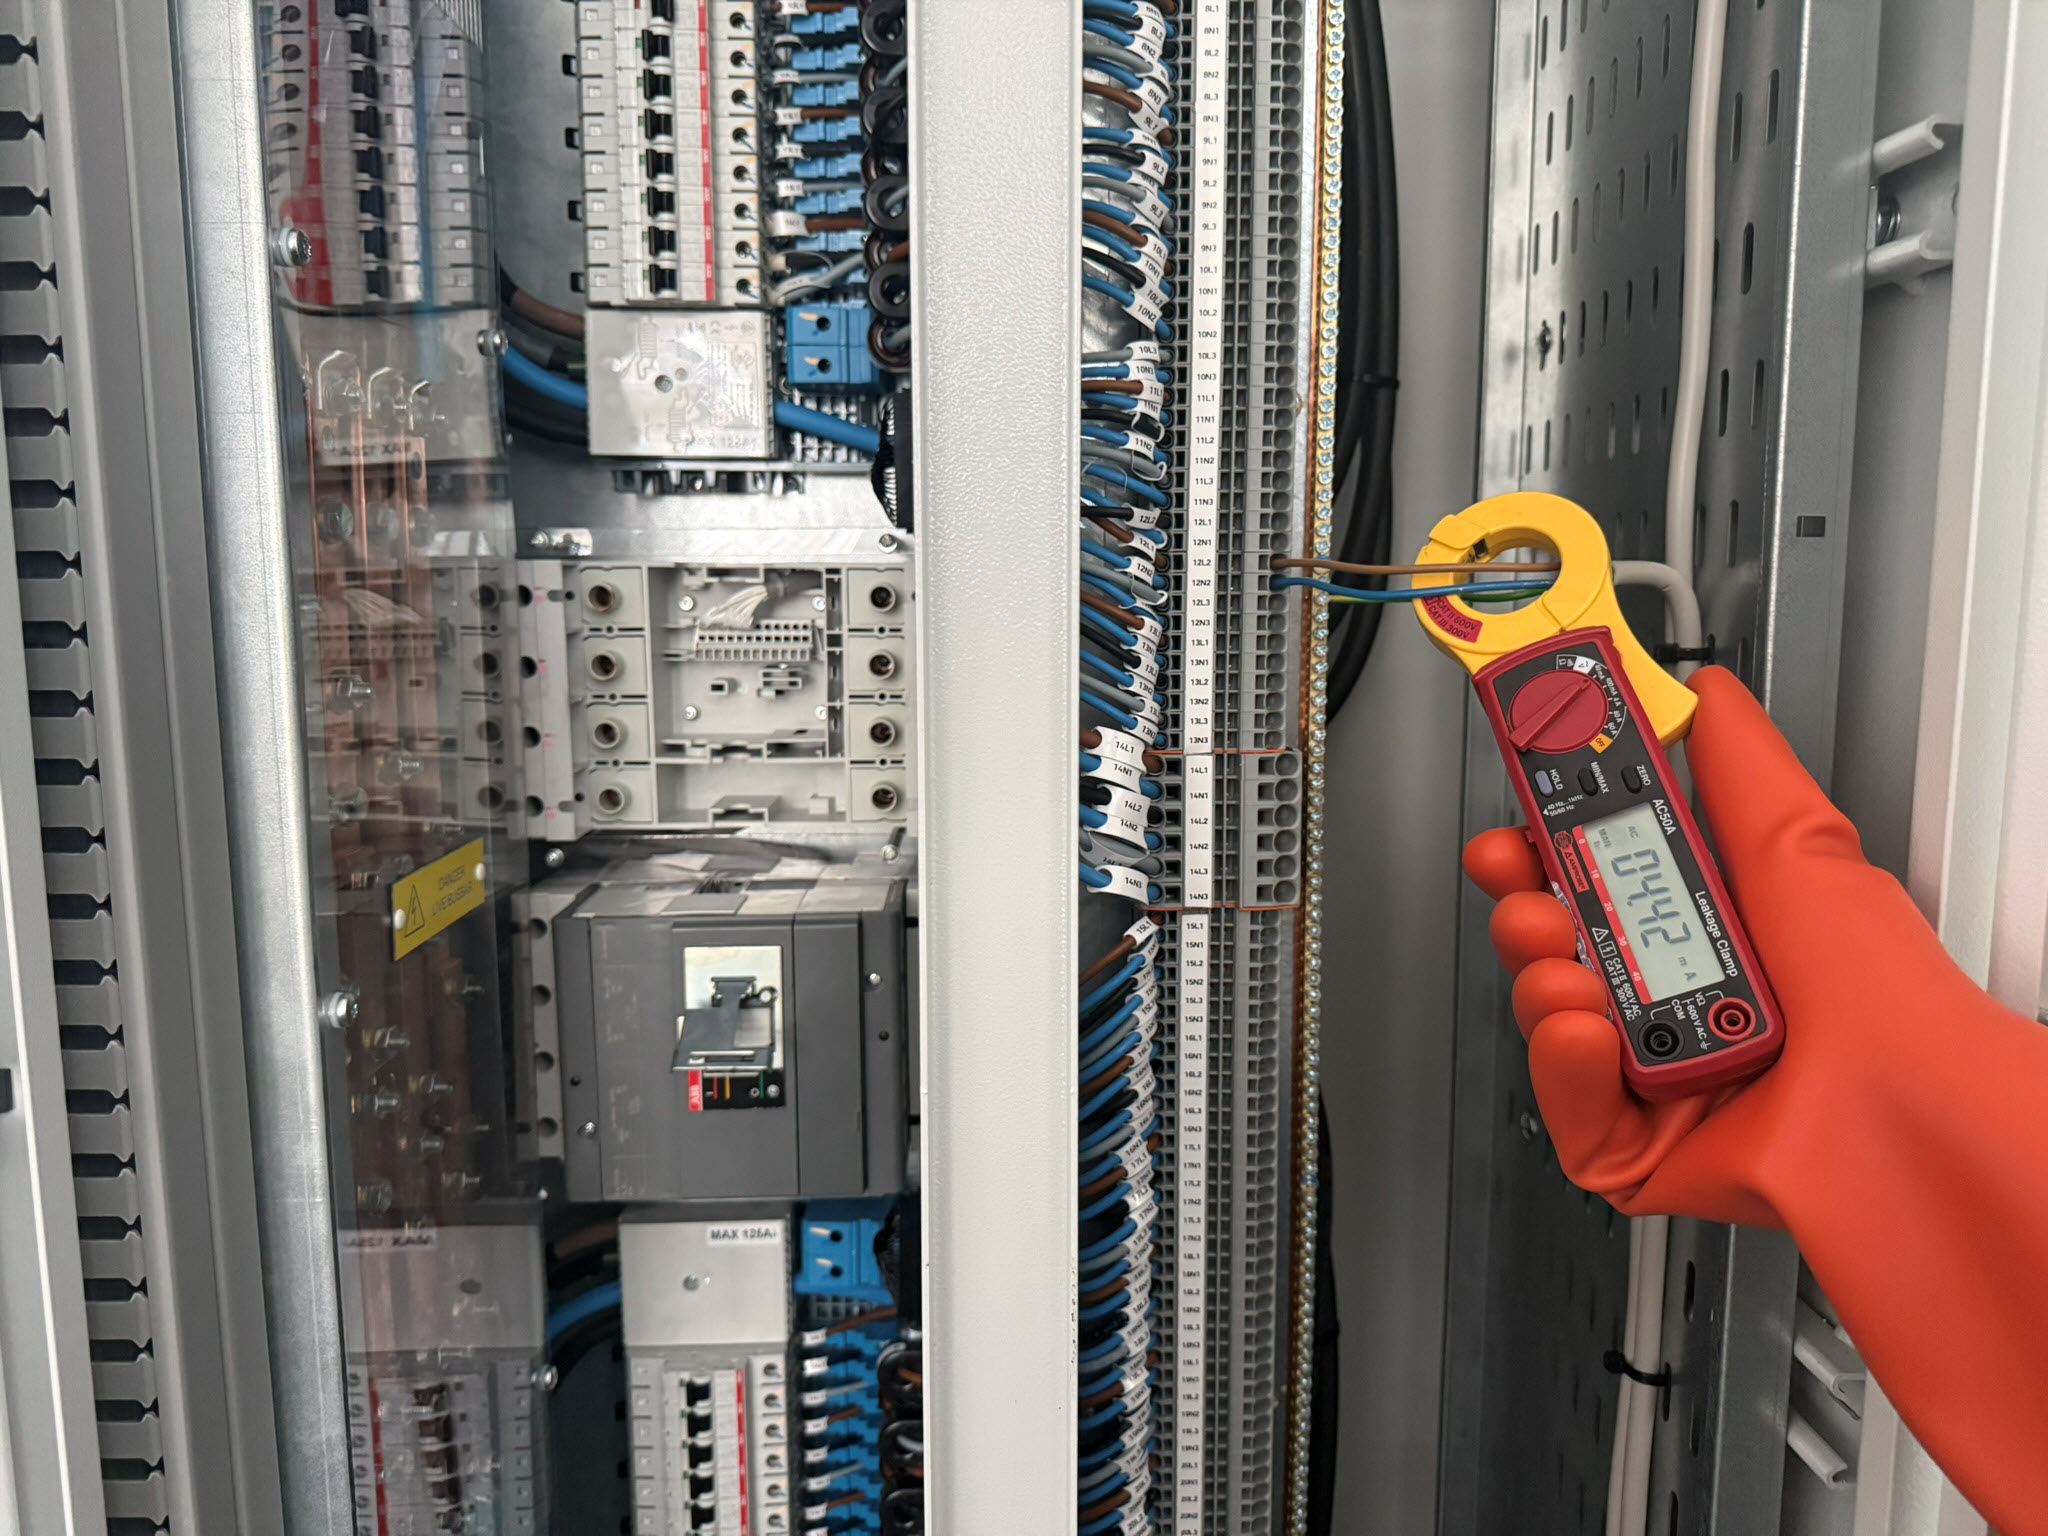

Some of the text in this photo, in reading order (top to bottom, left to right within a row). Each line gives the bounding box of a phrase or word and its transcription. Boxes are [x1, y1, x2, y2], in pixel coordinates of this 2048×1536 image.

[1204, 4, 1219, 13] 8L1
[1150, 26, 1163, 41] 8L2
[1203, 26, 1220, 35] 8N1
[1141, 42, 1156, 58] 8N2
[1204, 49, 1220, 57] 8L2
[1203, 71, 1220, 79] 8N2
[1203, 92, 1219, 101] 8L3
[1143, 116, 1158, 131] 9L1
[1202, 115, 1219, 123] 8N3
[1202, 136, 1218, 145] 9L1
[1201, 158, 1218, 166] 9N1
[1152, 162, 1165, 176] 9L2
[1202, 179, 1218, 188] 9L2
[1201, 201, 1218, 209] 9N2
[1150, 204, 1164, 219] 9L3
[1201, 222, 1217, 231] 9L3
[1200, 244, 1217, 252] 9N3
[1145, 260, 1160, 279] 10N1
[1199, 265, 1218, 274] 10L1
[1198, 287, 1218, 296] 10N1
[1138, 305, 1156, 322] 10N2
[1198, 308, 1218, 317] 10L2
[1197, 330, 1218, 338] 10N2
[1139, 346, 1157, 355] 10L3
[1197, 352, 1217, 360] 10L3
[1196, 373, 1217, 381] 10N3
[1196, 394, 1215, 402] 11L1
[1195, 415, 1215, 424] 11N1
[1195, 436, 1215, 445] 11L2
[1194, 456, 1215, 465] 11N2
[1194, 477, 1214, 486] 11L3
[1193, 498, 1214, 506] 11N3
[1193, 518, 1212, 526] 12L1
[1139, 539, 1155, 552] 12L1
[1192, 538, 1212, 547] 12N1
[1192, 558, 1212, 567] 12L2
[1191, 578, 1212, 587] 12N2
[1191, 598, 1211, 607] 12L3
[1190, 618, 1211, 627] 12N3
[1428, 605, 1442, 620] CAT
[1446, 624, 1470, 639] 300V
[1454, 616, 1477, 631] 600V
[1191, 638, 1209, 647] 13L1
[1189, 658, 1209, 667] 13N1
[1190, 678, 1210, 686] 13L2
[1189, 697, 1210, 706] 13N2
[1189, 717, 1209, 725] 13L3
[1188, 736, 1209, 744] 13N3
[1595, 737, 1605, 747] OFF
[1115, 741, 1135, 754] 14L1
[1113, 763, 1133, 777] 14N1
[1189, 766, 1208, 774] 14L1
[1549, 769, 1564, 791] HOLD
[1590, 761, 1610, 794] MIN/MAX
[1636, 765, 1651, 786] ZERO
[1189, 792, 1209, 800] 14N1
[1124, 800, 1143, 813] 14L2
[1189, 817, 1209, 825] 14L2
[1652, 798, 1677, 836] AC50A
[1120, 819, 1139, 832] 14N2
[1627, 826, 1639, 839] AC
[1189, 842, 1209, 850] 14N2
[1189, 867, 1209, 876] 14L3
[1591, 869, 1601, 879] 10
[1125, 877, 1142, 889] 14N3
[1188, 893, 1209, 901] 14N3
[1603, 901, 1614, 912] 20
[1136, 920, 1153, 935] 15L1
[1186, 922, 1204, 930] 15L1
[1694, 890, 1739, 978] Leakage Clamp
[1185, 941, 1204, 949] 15N1
[1617, 935, 1628, 947] 30
[1185, 959, 1204, 967] 15L2
[1612, 957, 1626, 975] CAT
[1605, 959, 1618, 978] CAT
[1632, 971, 1642, 982] 40
[1184, 978, 1204, 986] 15N2
[1185, 996, 1204, 1004] 15L3
[1671, 999, 1687, 1020] COM
[1184, 1015, 1204, 1023] 15N3
[711, 1229, 738, 1240] MAX
